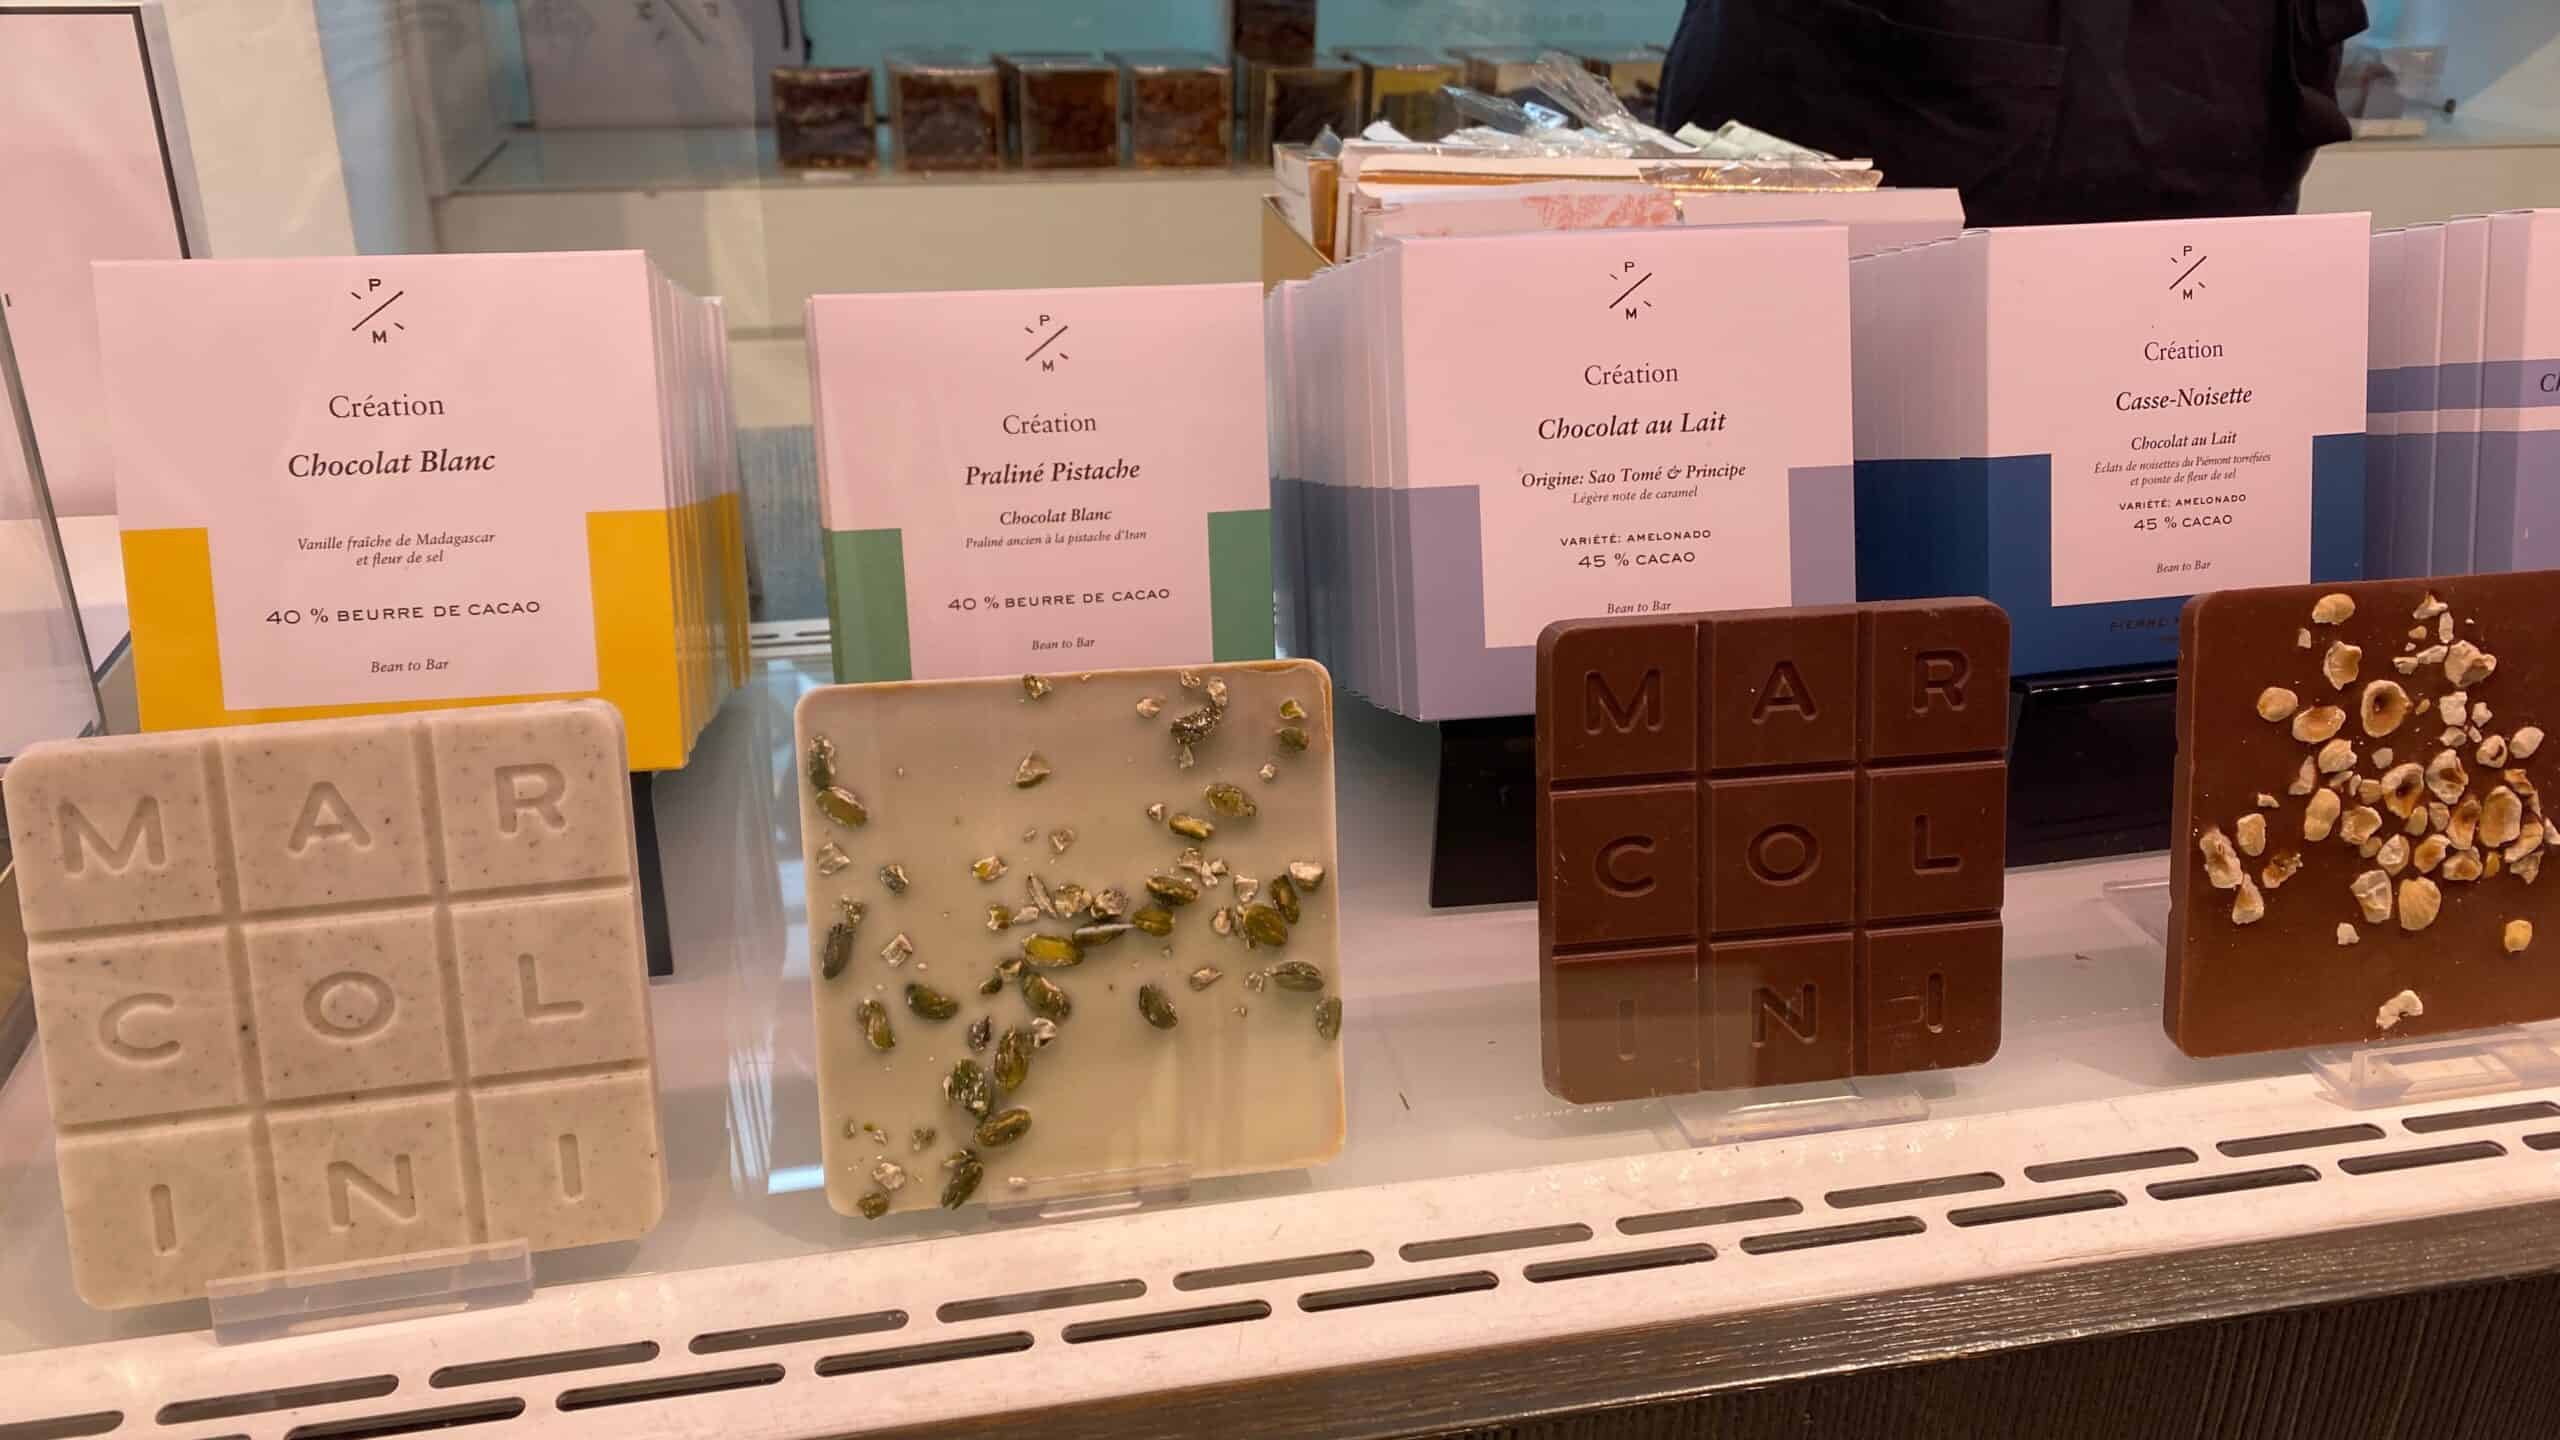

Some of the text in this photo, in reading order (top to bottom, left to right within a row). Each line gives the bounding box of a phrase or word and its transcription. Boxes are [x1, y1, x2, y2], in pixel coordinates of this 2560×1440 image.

[2184, 245, 2192, 256] P
[1624, 261, 1635, 272] P
[368, 278, 381, 292] P
[2183, 289, 2192, 300] M
[1040, 315, 1050, 326] P
[1626, 308, 1637, 320] M
[372, 330, 387, 344] M
[2145, 340, 2223, 361] Création
[1042, 360, 1054, 372] M
[1585, 363, 1678, 385] Création
[329, 394, 444, 418] Création
[2116, 387, 2252, 411] Casse-Noisette
[1003, 413, 1096, 434] Création
[1539, 411, 1726, 439] Chocolat au Lait
[2131, 432, 2237, 451] Chocolat au Lait
[289, 448, 495, 477] Chocolat Blanc
[966, 458, 1140, 485] Praliné Pistache
[2125, 460, 2137, 472] de
[2139, 458, 2180, 471] noisettes
[2180, 456, 2195, 468] du
[1522, 464, 1746, 490] Origine: Sao Tomé & Principe
[2130, 468, 2236, 488] et pointe de fleur de sel
[1573, 485, 1698, 506] Légère note de caramel
[2175, 494, 2246, 506] AMELONADO
[1000, 507, 1112, 525] Chocolat Blanc
[2134, 514, 2232, 530] 45 % CACAO
[298, 531, 496, 552] Vanille fraîche de Madagascar
[966, 536, 1003, 548] Praliné
[1006, 536, 1042, 546] ancien
[1055, 532, 1064, 543] la
[1067, 528, 1111, 545] pistache
[1627, 530, 1711, 544] AMELONADO
[356, 549, 444, 567] et fleur de sel
[1578, 552, 1695, 568] 45 % CACAO
[2156, 560, 2211, 574] Bean to Bar
[948, 589, 1169, 611] 40 % BEURRE DE CACAO
[1608, 600, 1671, 613] Bean to Bar
[266, 601, 540, 624] 40 % BEURRE DE CACAO
[1032, 637, 1095, 650] Bean to Bar
[371, 658, 448, 673] Bean to Bar
